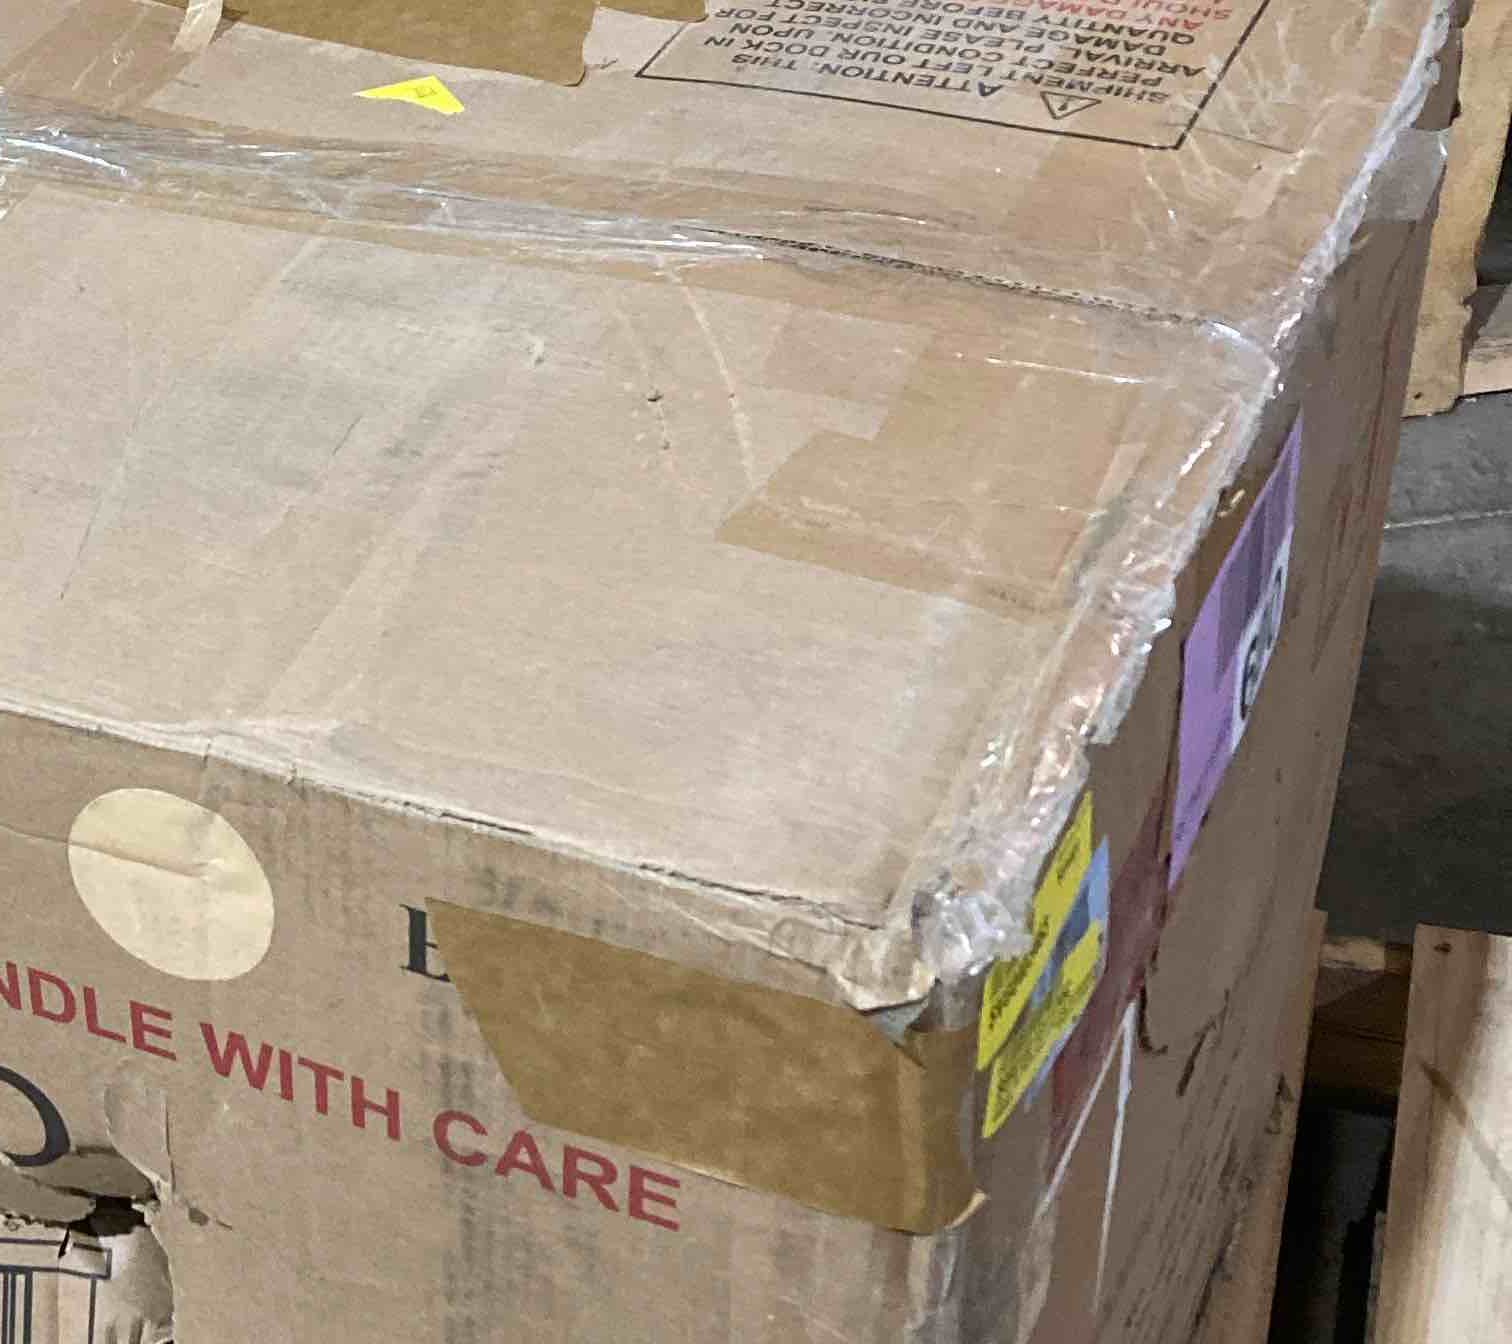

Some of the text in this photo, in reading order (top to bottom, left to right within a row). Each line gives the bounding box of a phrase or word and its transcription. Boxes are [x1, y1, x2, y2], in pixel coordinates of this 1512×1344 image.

[714, 8, 777, 22] FOR
[783, 13, 914, 38] INSPECT
[952, 18, 1019, 34] AND
[1134, 14, 1203, 31] ANY
[728, 20, 817, 42] UPON
[918, 28, 1045, 53] PLEASE
[1026, 26, 1166, 56] DAMAGE
[1031, 14, 1195, 46] QUANTITY
[703, 35, 1169, 104] SHIPMENT LEFT OUR DOCK IN
[732, 53, 799, 71] THIS
[1013, 54, 1168, 87] PERFECT
[201, 1021, 401, 1141] WITH
[433, 1110, 681, 1231] CARE
